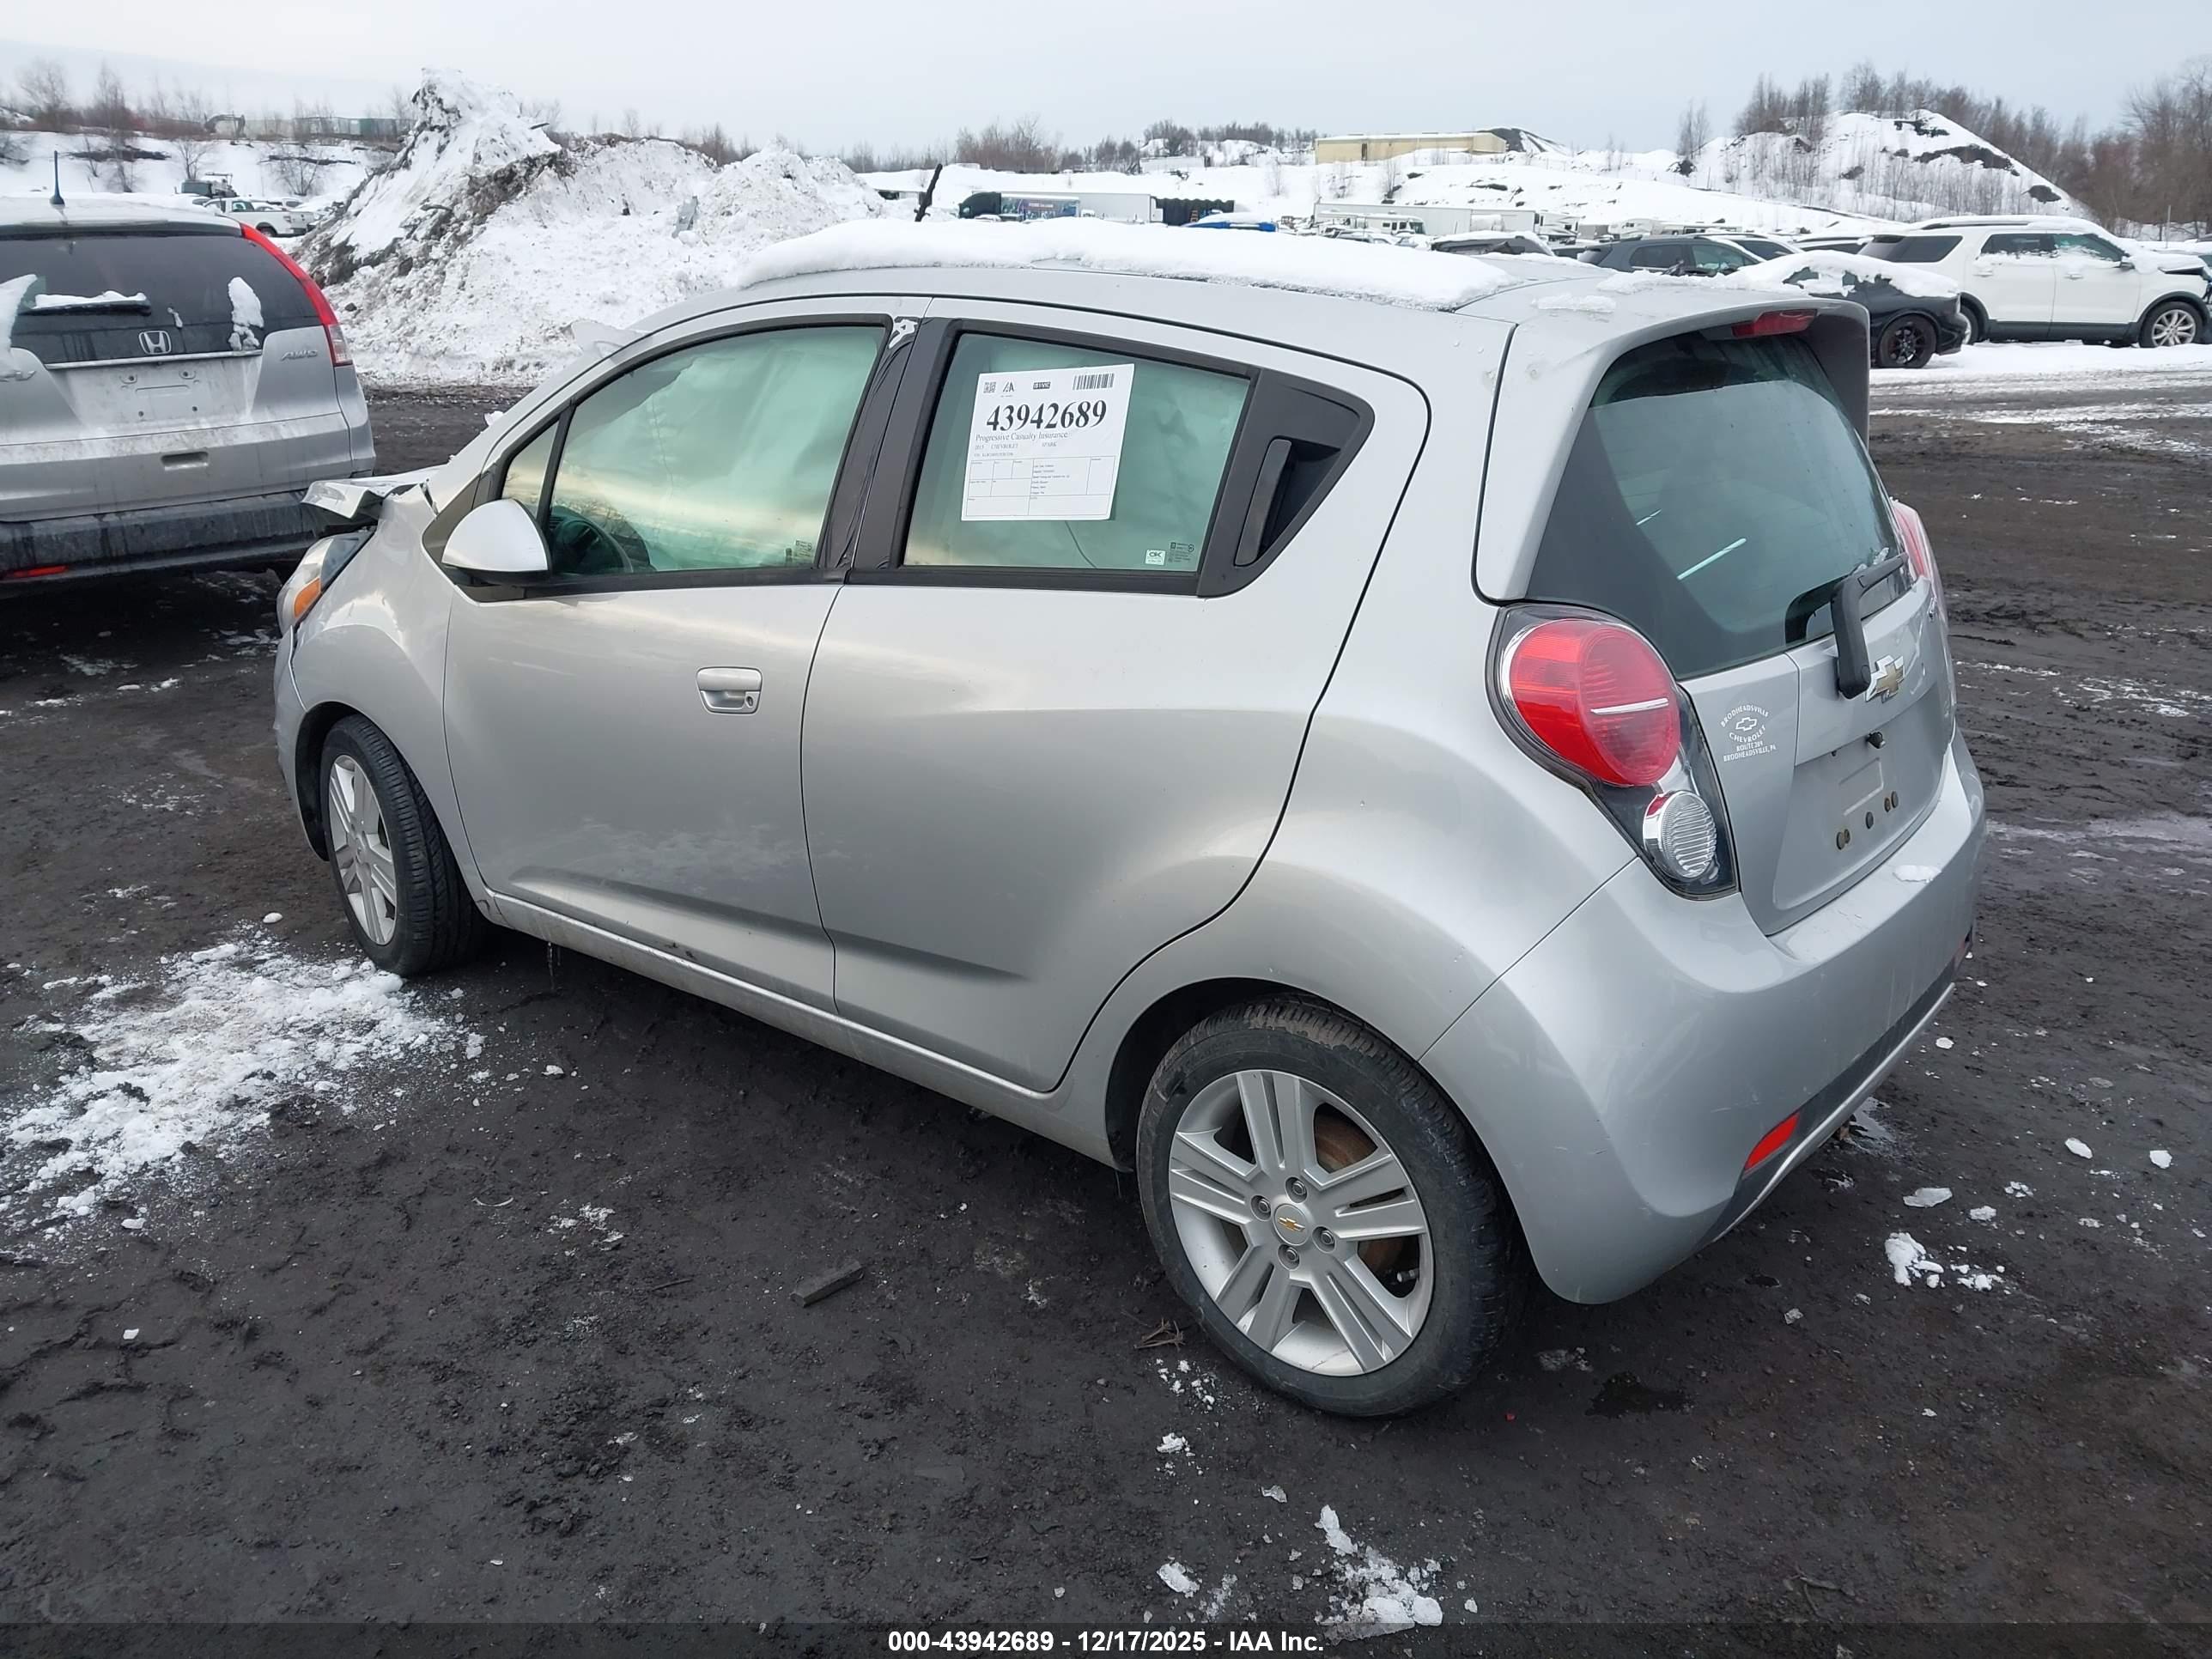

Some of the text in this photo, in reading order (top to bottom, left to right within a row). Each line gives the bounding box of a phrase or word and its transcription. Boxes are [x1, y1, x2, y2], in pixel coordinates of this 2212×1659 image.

[987, 399, 1107, 431] 43942689
[975, 431, 1068, 443] Progressive Casualty Insurance
[1720, 704, 1769, 727] BRODHEADSVILLE
[1729, 724, 1765, 743] CHEVROLET
